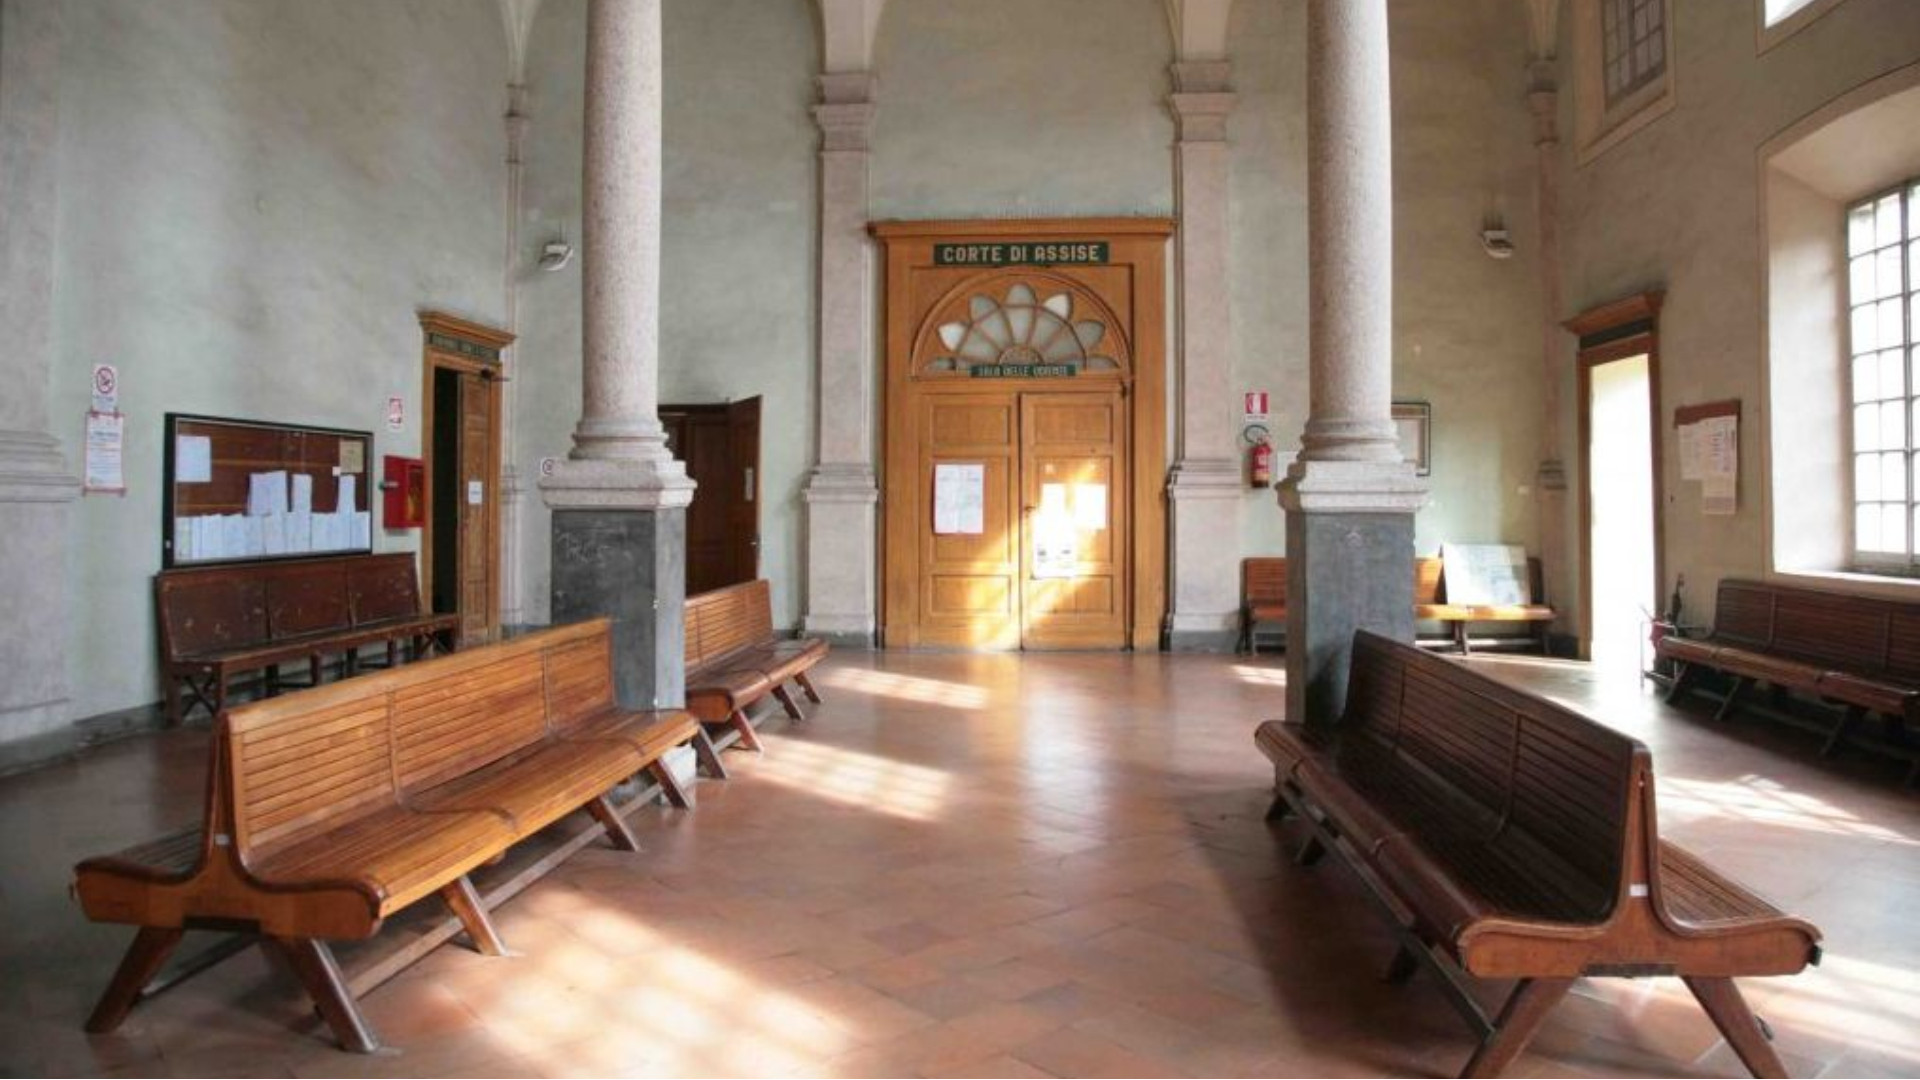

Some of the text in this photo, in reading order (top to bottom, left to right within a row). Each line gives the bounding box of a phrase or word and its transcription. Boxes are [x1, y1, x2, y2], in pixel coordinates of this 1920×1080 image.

[943, 244, 1100, 263] CORTE DI ASSISE
